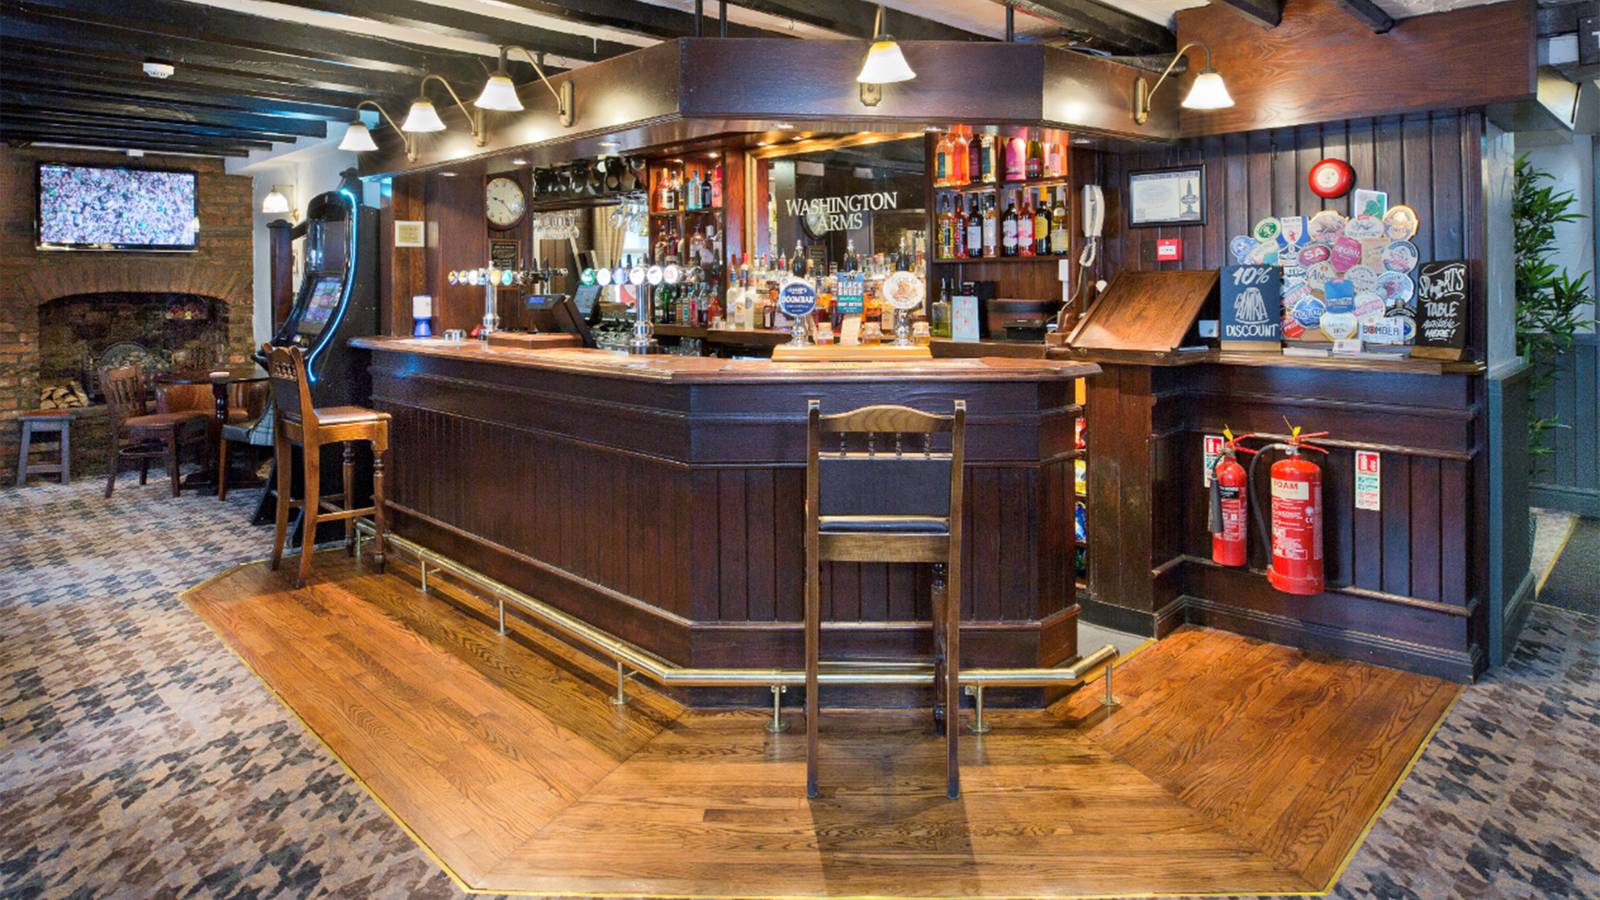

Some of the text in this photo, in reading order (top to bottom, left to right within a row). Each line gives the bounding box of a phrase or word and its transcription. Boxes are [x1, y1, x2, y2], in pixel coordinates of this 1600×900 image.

[785, 192, 897, 216] WASHINGTON
[818, 212, 863, 231] ARMS
[1232, 267, 1272, 285] 10%
[1424, 301, 1460, 318] TABLE
[1226, 324, 1279, 337] DISCOUNT
